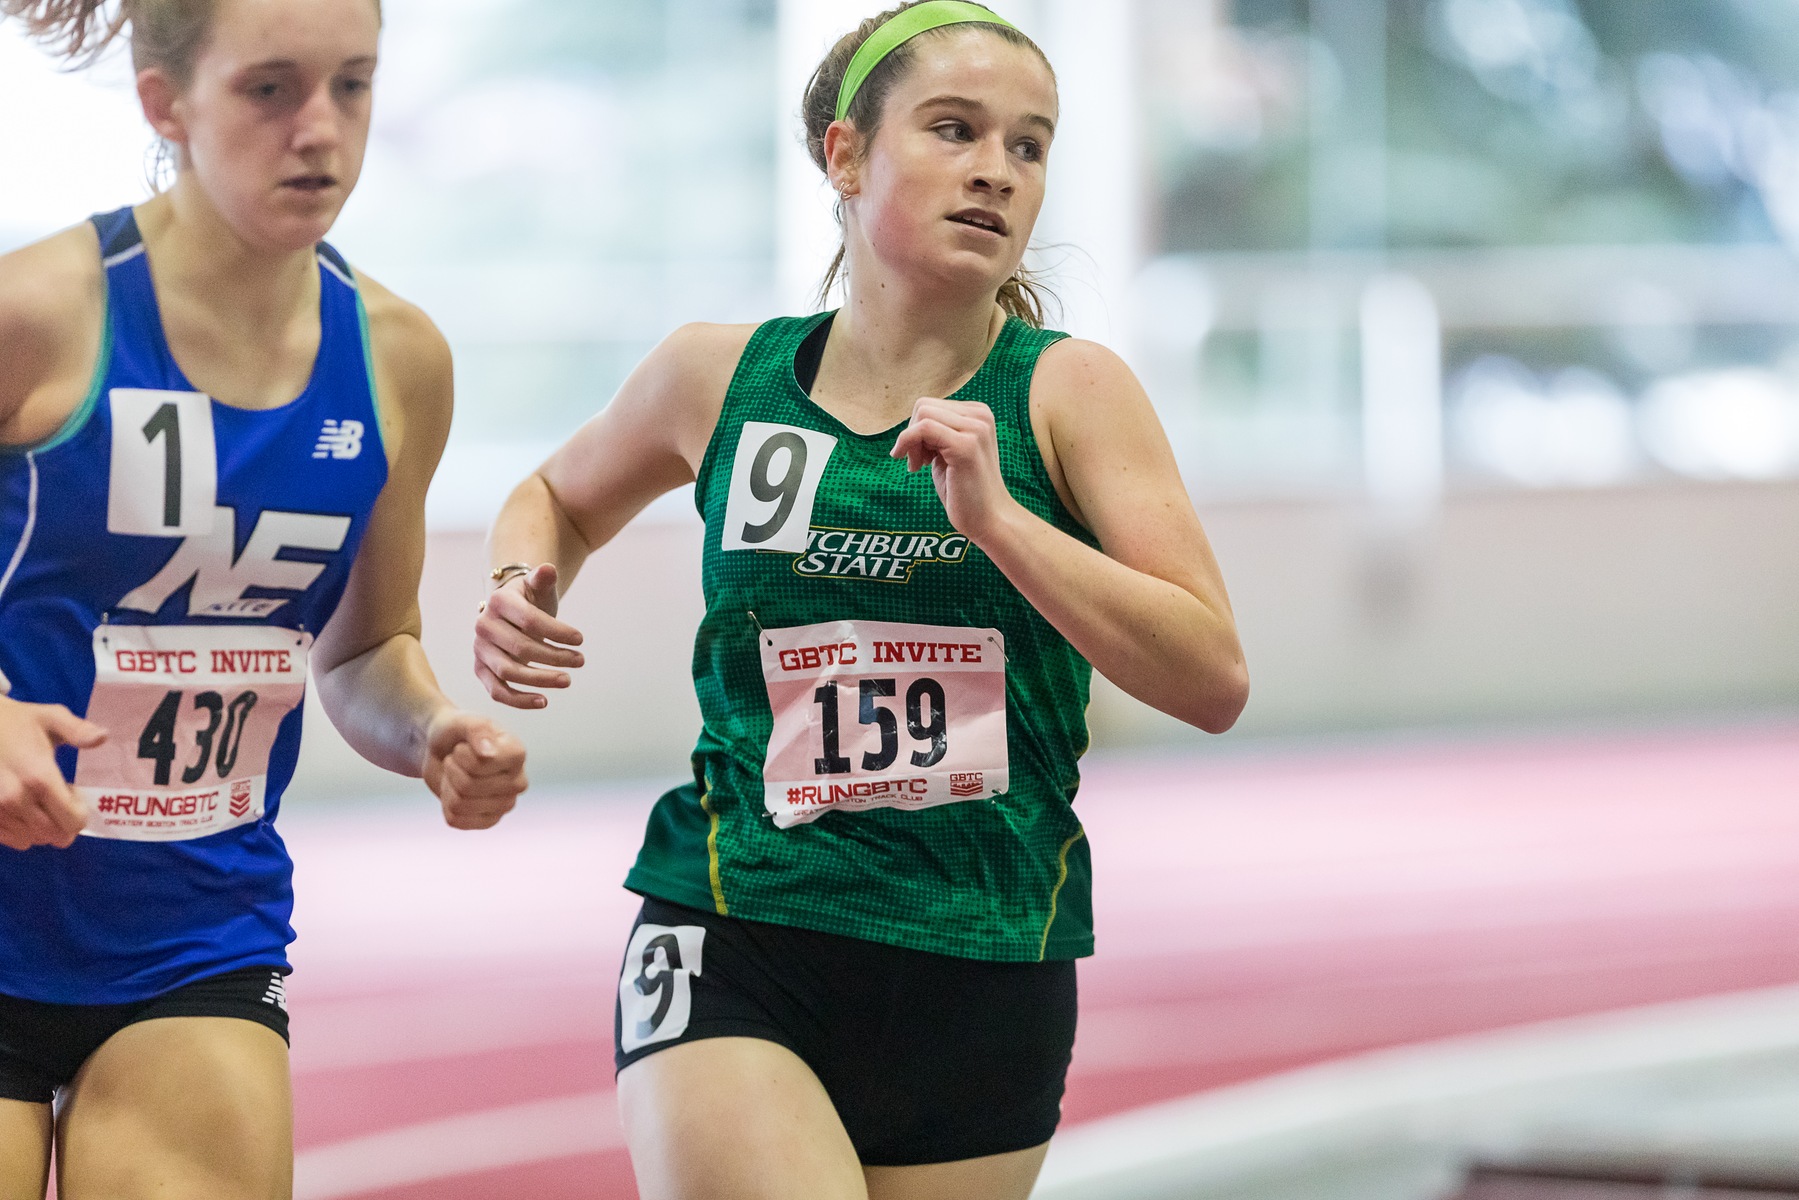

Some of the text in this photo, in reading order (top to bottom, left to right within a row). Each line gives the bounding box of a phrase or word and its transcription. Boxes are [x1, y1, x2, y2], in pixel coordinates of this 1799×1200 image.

[142, 403, 182, 527] 1
[741, 431, 808, 543] 9
[805, 530, 967, 559] TCHBURG
[797, 552, 912, 579] STATE
[115, 650, 293, 673] GBTC INVITE
[779, 641, 982, 671] GBTC INVITE
[137, 690, 258, 786] 430
[813, 677, 948, 775] 159
[786, 778, 928, 805] #RUNGBTC
[950, 772, 983, 782] GBTC
[98, 791, 219, 817] #RUNGBTC
[900, 793, 923, 801] CLUB
[633, 933, 683, 1041] 9
